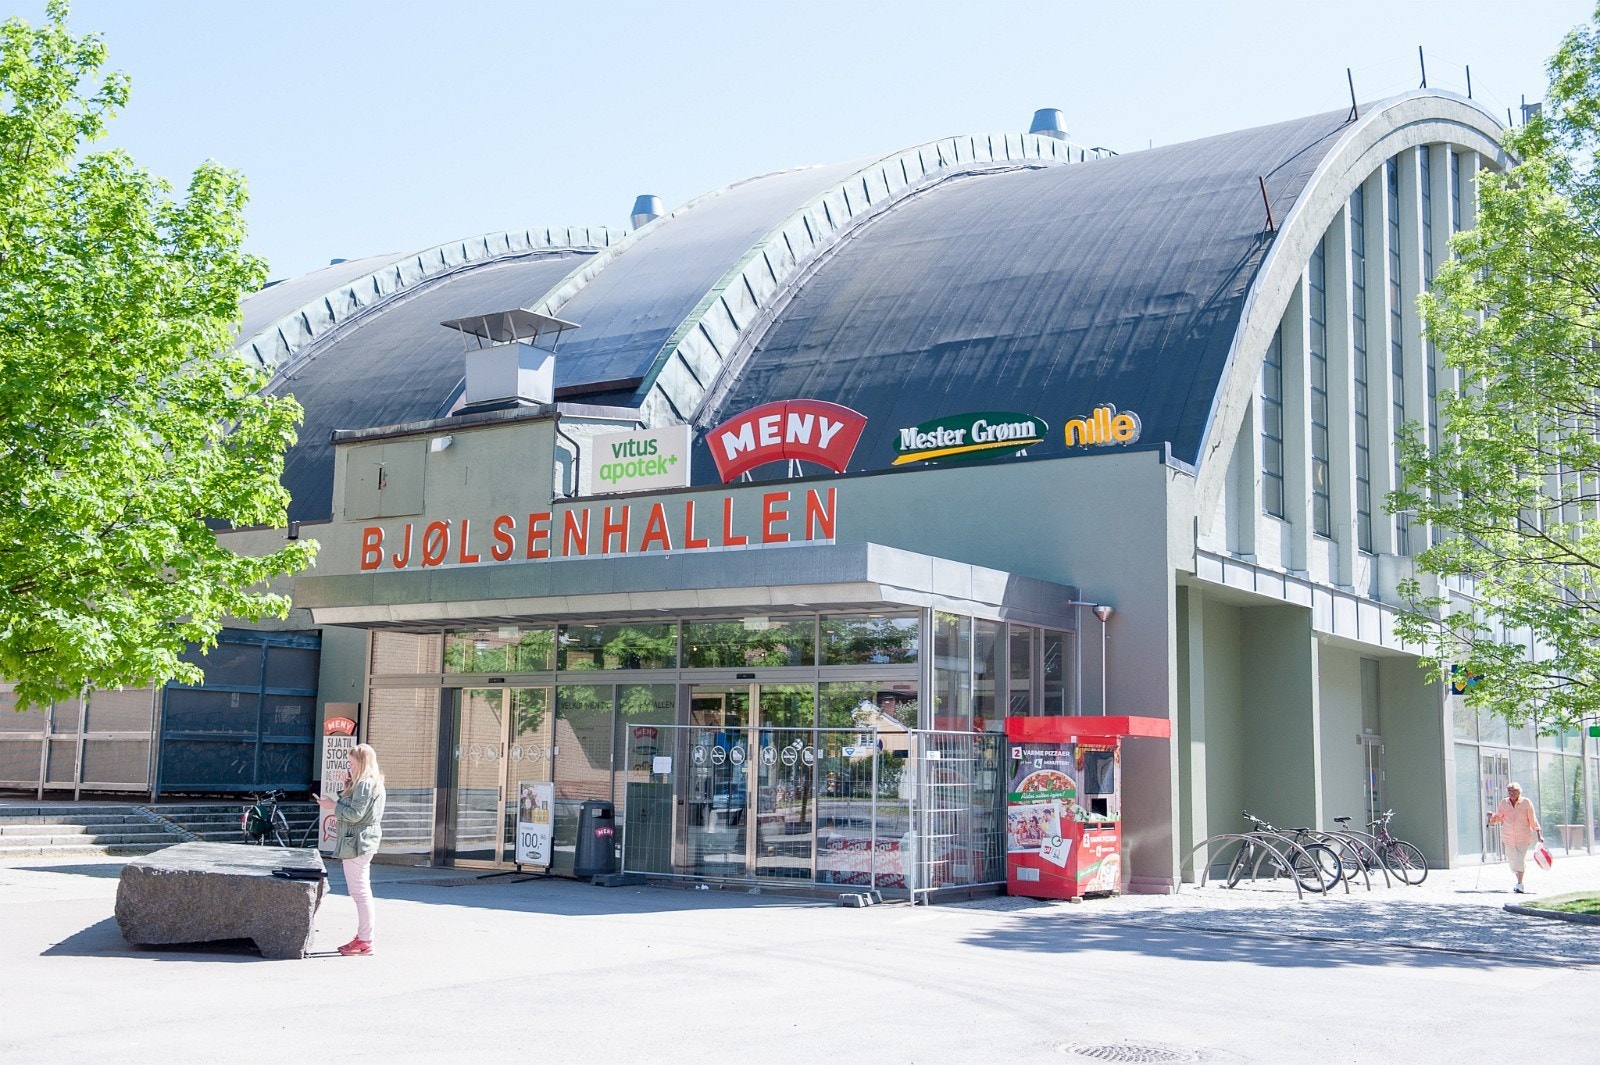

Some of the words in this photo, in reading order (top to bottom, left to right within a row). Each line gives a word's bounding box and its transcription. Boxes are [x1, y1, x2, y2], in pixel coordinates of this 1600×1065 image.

[900, 426, 965, 451] Mester
[971, 419, 1037, 443] Grønn
[1064, 405, 1137, 447] nille
[721, 413, 844, 461] MENY
[611, 438, 658, 459] vitus
[360, 487, 838, 572] BJØLSENHALLEN
[327, 720, 352, 731] MENY
[327, 738, 333, 748] SI
[334, 738, 342, 748] JA
[343, 738, 352, 748] TIL
[1014, 749, 1020, 757] 2
[326, 749, 348, 760] STOR
